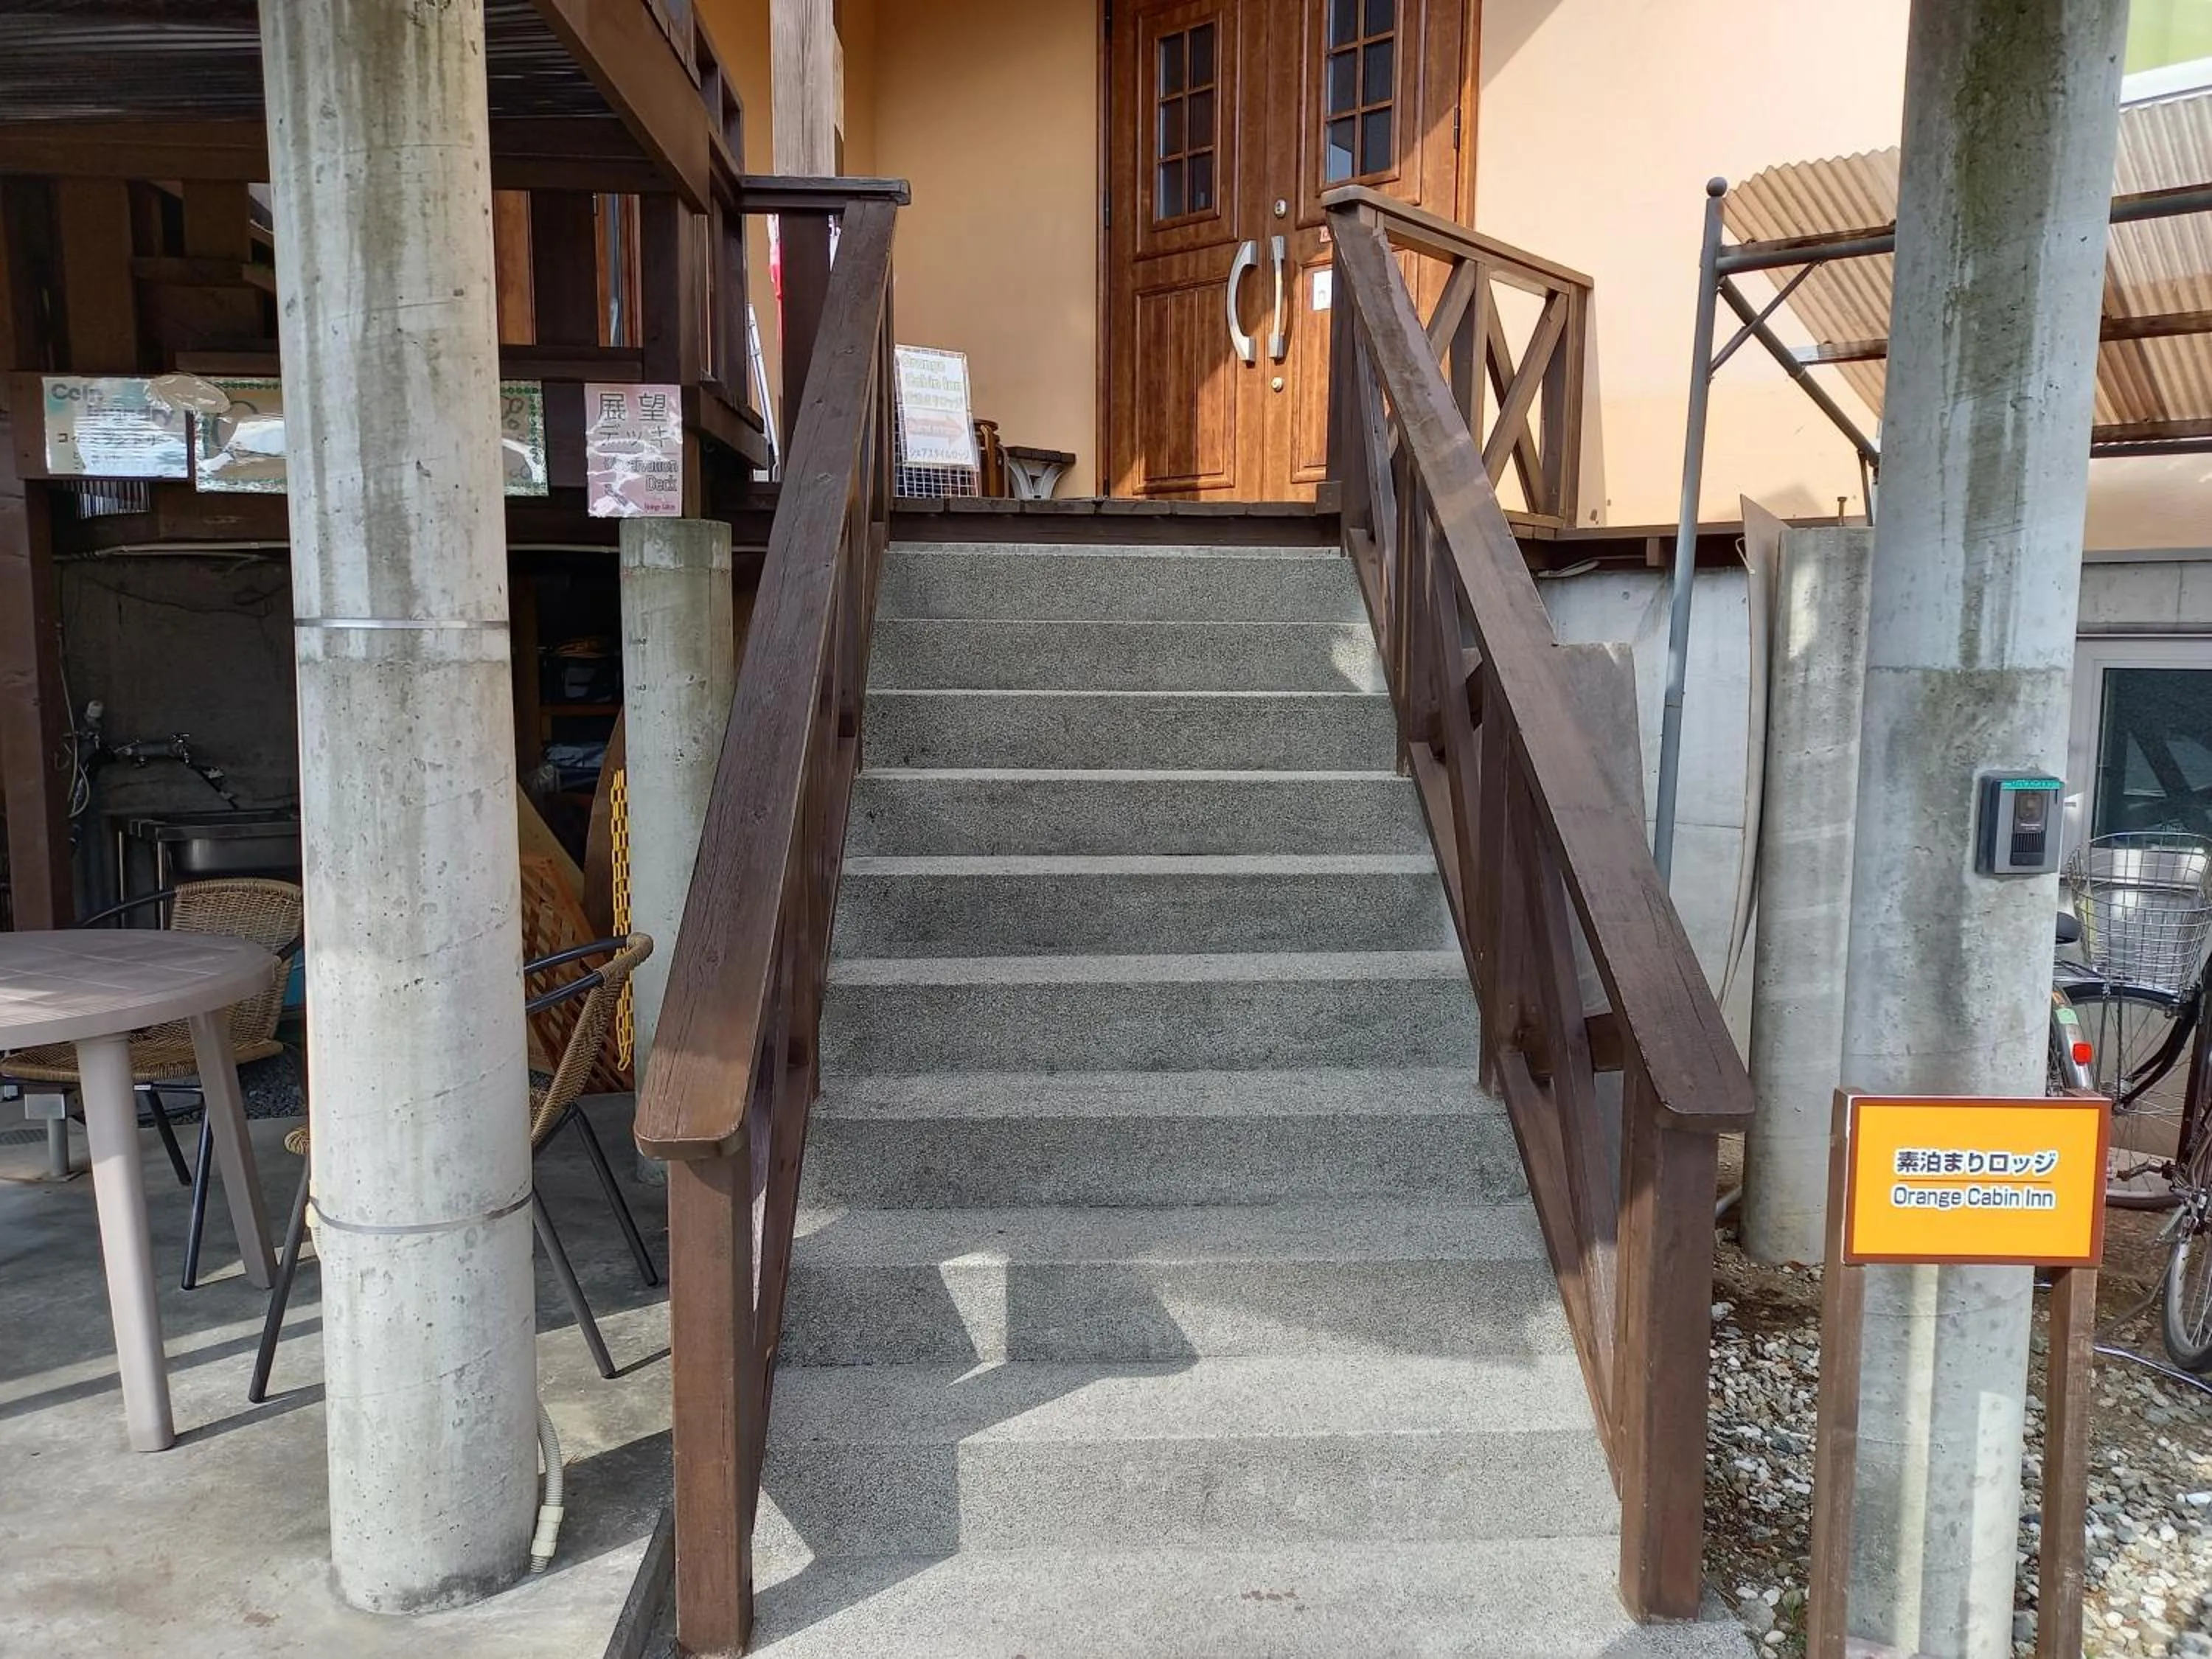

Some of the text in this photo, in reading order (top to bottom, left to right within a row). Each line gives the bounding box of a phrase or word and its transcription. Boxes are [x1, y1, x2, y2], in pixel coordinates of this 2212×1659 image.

[599, 392, 667, 421] 展望
[645, 474, 678, 491] Deck
[1897, 1151, 2056, 1173] 素泊まりロッジ
[1894, 1186, 2053, 1207] Orange Cabin Inn
